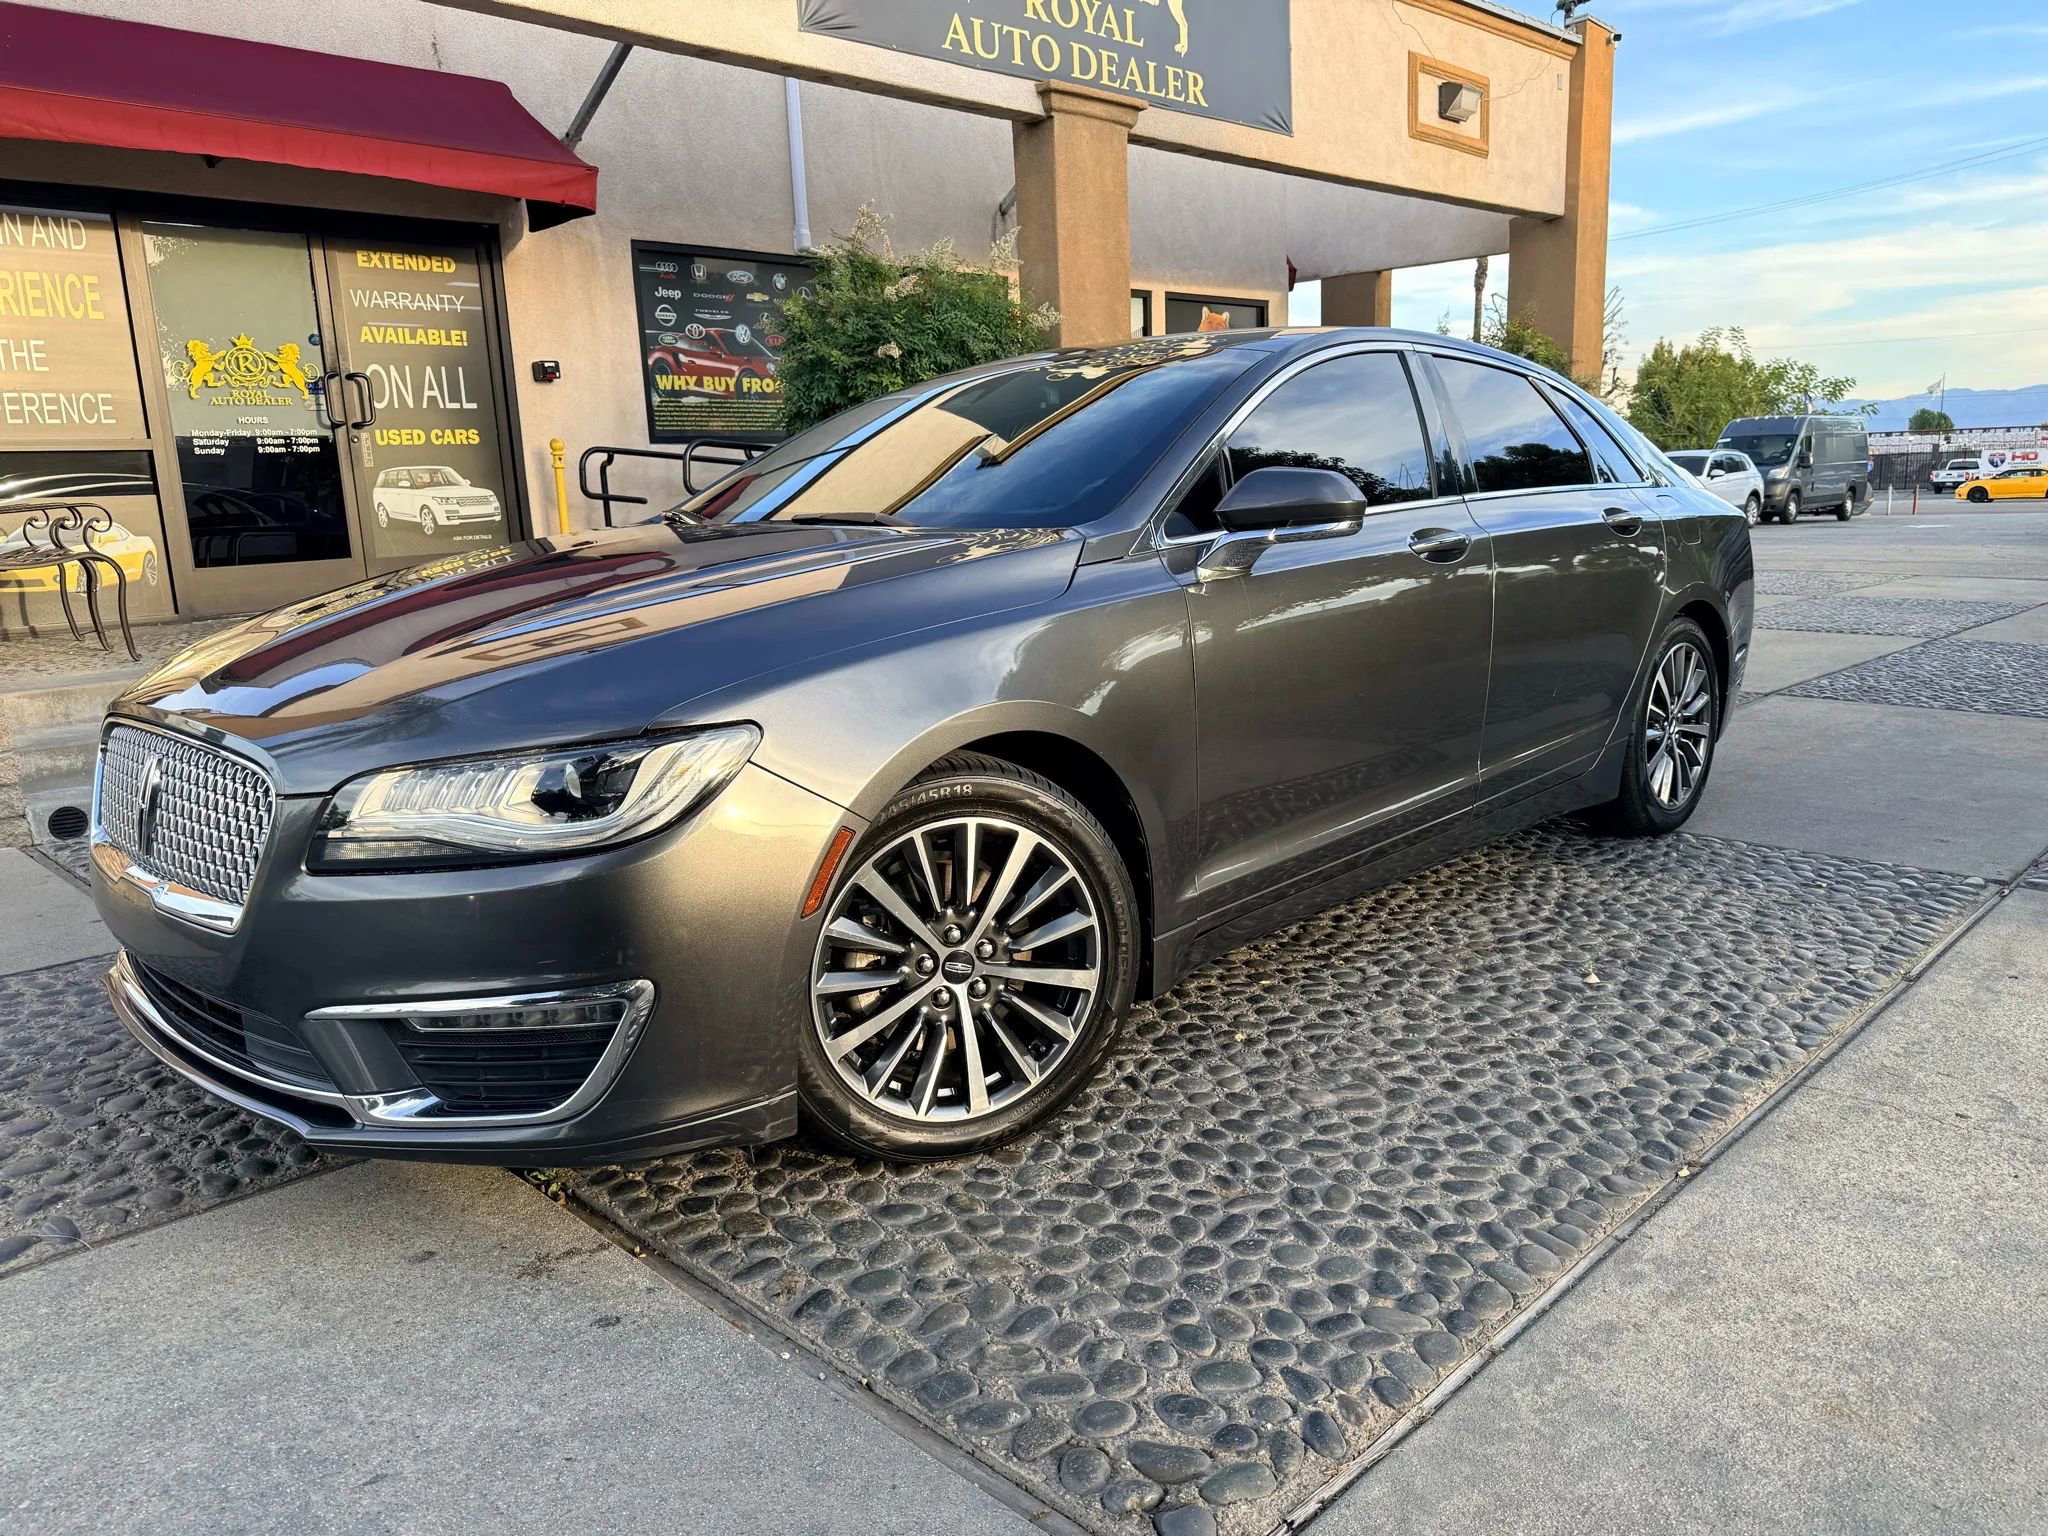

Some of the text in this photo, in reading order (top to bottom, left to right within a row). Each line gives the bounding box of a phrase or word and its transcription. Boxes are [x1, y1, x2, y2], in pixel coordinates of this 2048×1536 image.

[1024, 0, 1144, 47] ROYAL
[941, 13, 1209, 107] AUTO DEALER
[31, 215, 87, 250] AND
[356, 250, 456, 273] EXTENDED
[349, 288, 465, 313] WARRANTY
[654, 286, 681, 300] Jeep
[693, 292, 728, 300] DODGE
[360, 326, 468, 347] AVAILABLE!
[364, 363, 478, 409] ON ALL
[655, 374, 697, 390] WHY
[702, 376, 737, 392] BUY
[210, 397, 293, 406] AUTO DEALER
[231, 389, 272, 398] ROYAL
[237, 416, 269, 424] HOURS
[191, 428, 251, 438] Monday-Friday
[254, 428, 284, 436] 9:00am
[289, 428, 318, 437] 7:00pm
[192, 438, 230, 447] Saturday
[256, 437, 285, 445] 9:00am
[291, 437, 319, 446] 7:00pm
[374, 428, 480, 446] USED CARS
[194, 447, 226, 456] Sunday
[257, 446, 287, 454] 9:00am
[292, 446, 321, 455] 7:00pm
